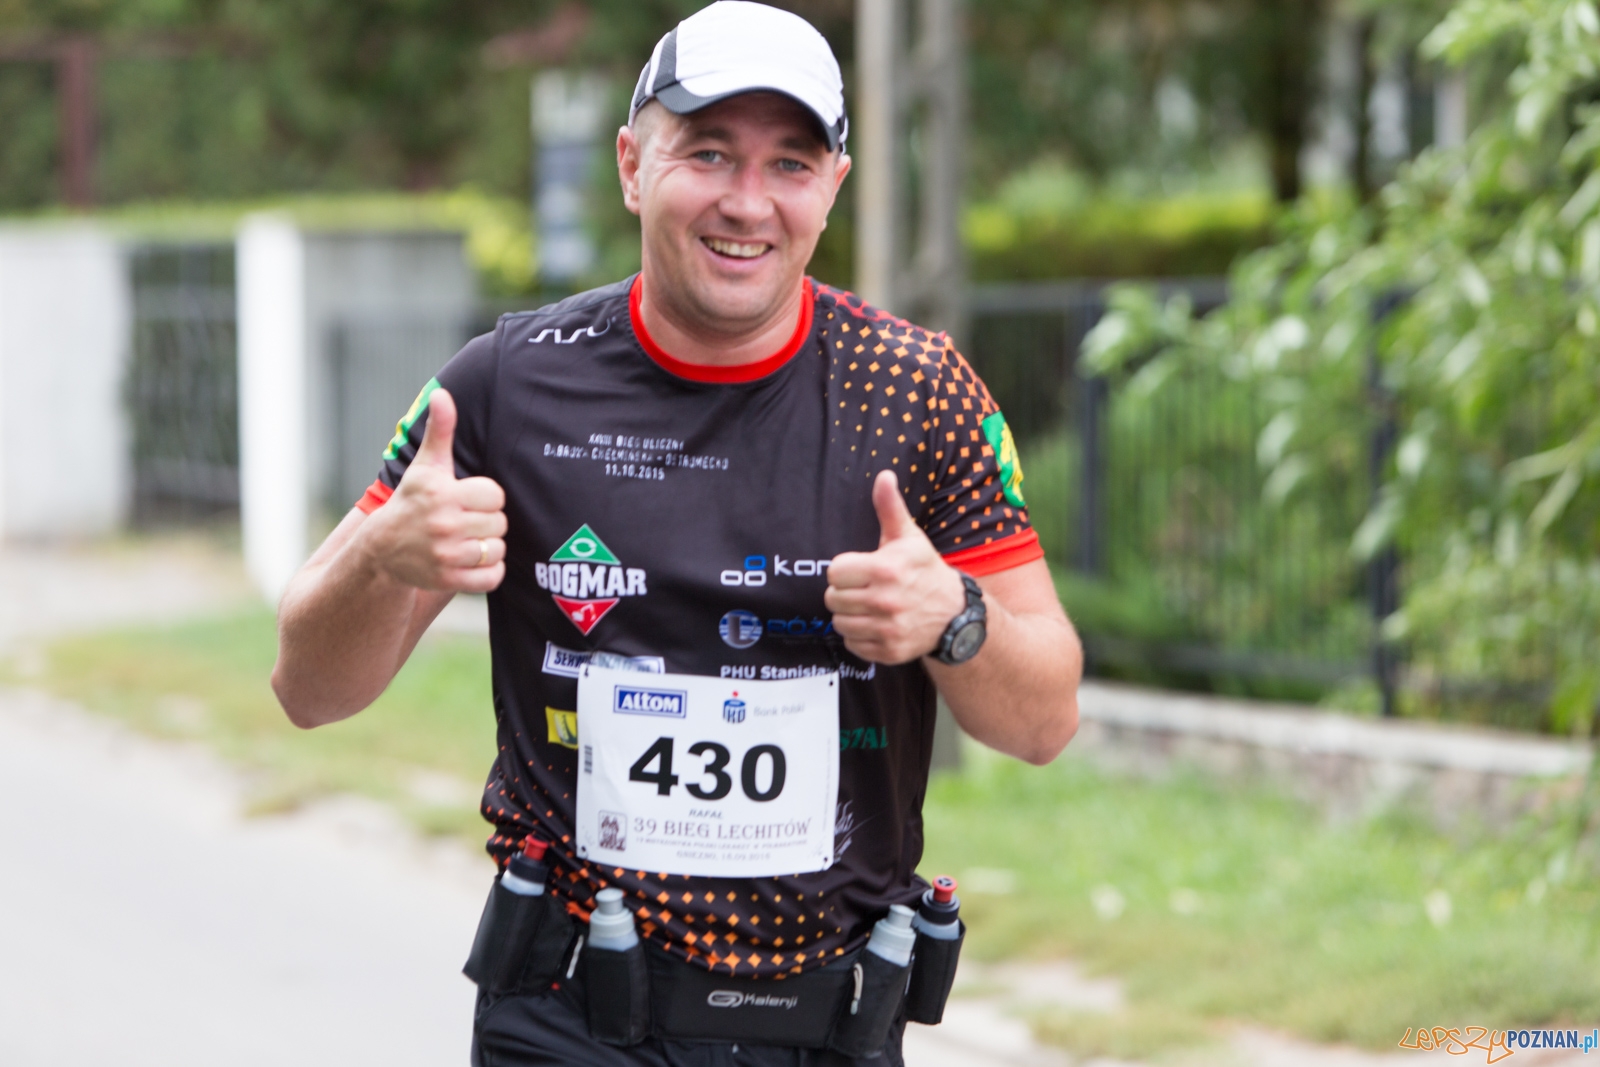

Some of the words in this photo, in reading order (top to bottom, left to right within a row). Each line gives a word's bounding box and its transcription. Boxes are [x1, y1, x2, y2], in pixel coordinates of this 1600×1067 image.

[616, 435, 641, 449] BIEG
[605, 463, 665, 480] 11.10.2015
[535, 562, 647, 598] BOGMAR
[720, 665, 756, 678] PHU
[629, 736, 786, 802] 430
[688, 808, 723, 819] RAFAŁ
[634, 817, 657, 835] 39
[664, 820, 710, 838] BIEG
[717, 817, 812, 839] LECHITÓW
[744, 993, 798, 1010] Kalenji
